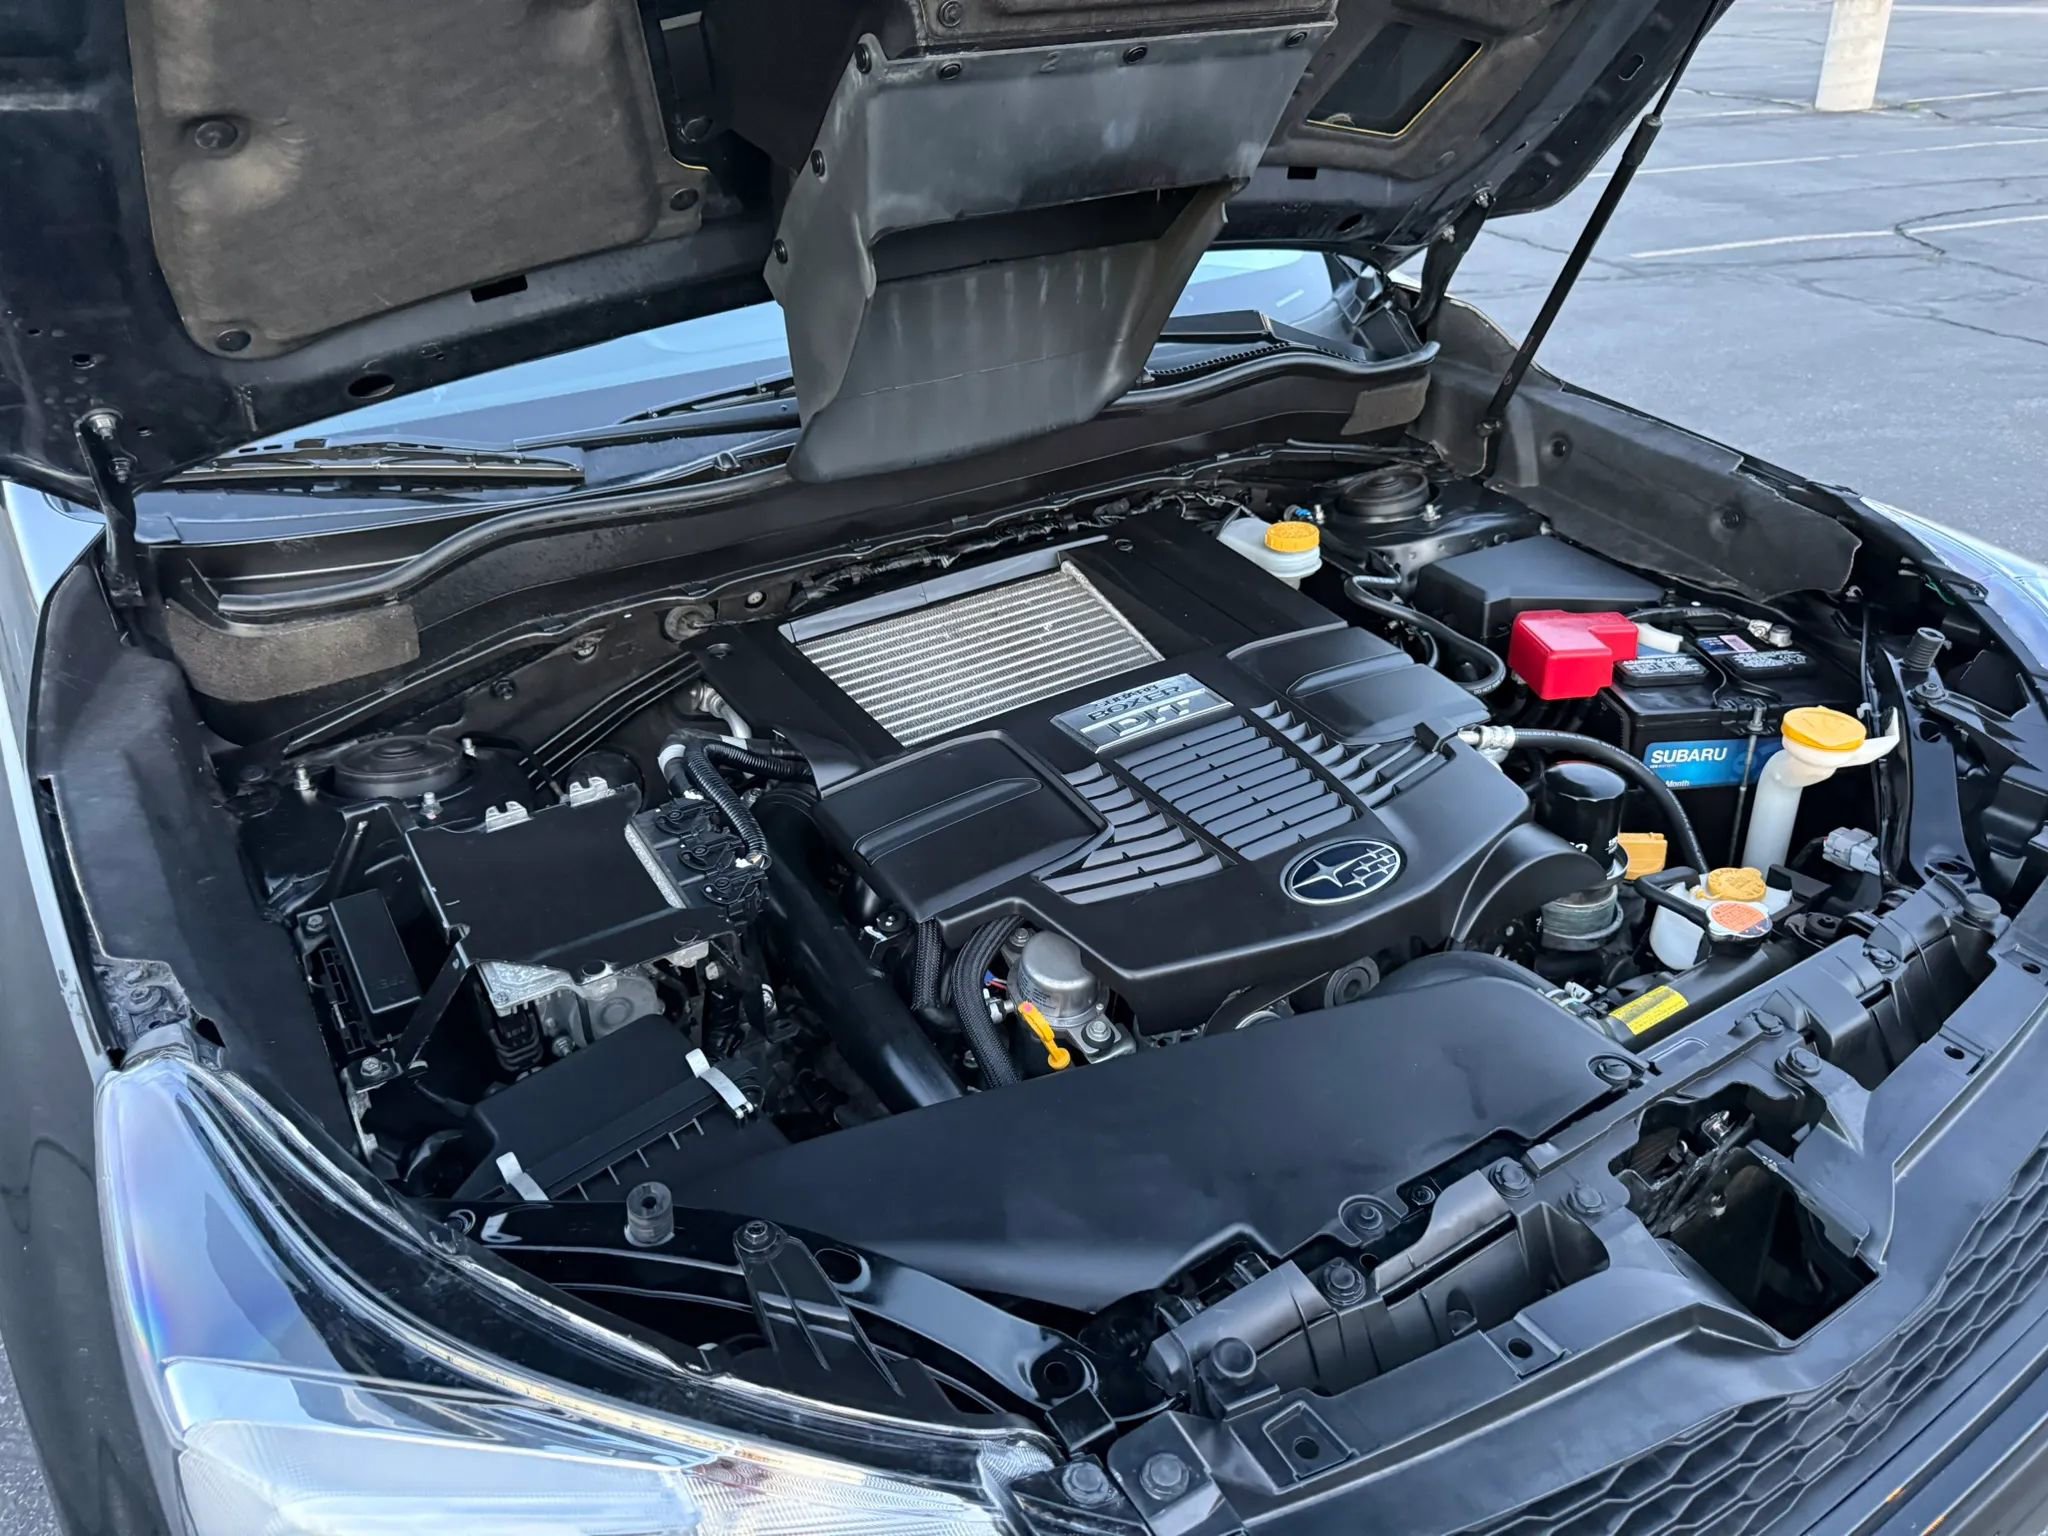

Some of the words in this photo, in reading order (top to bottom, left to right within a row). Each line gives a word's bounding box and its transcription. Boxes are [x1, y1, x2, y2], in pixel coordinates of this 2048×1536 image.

[1088, 686, 1183, 721] BOXER
[1107, 698, 1190, 737] DIT
[1650, 747, 1728, 764] SUBARU
